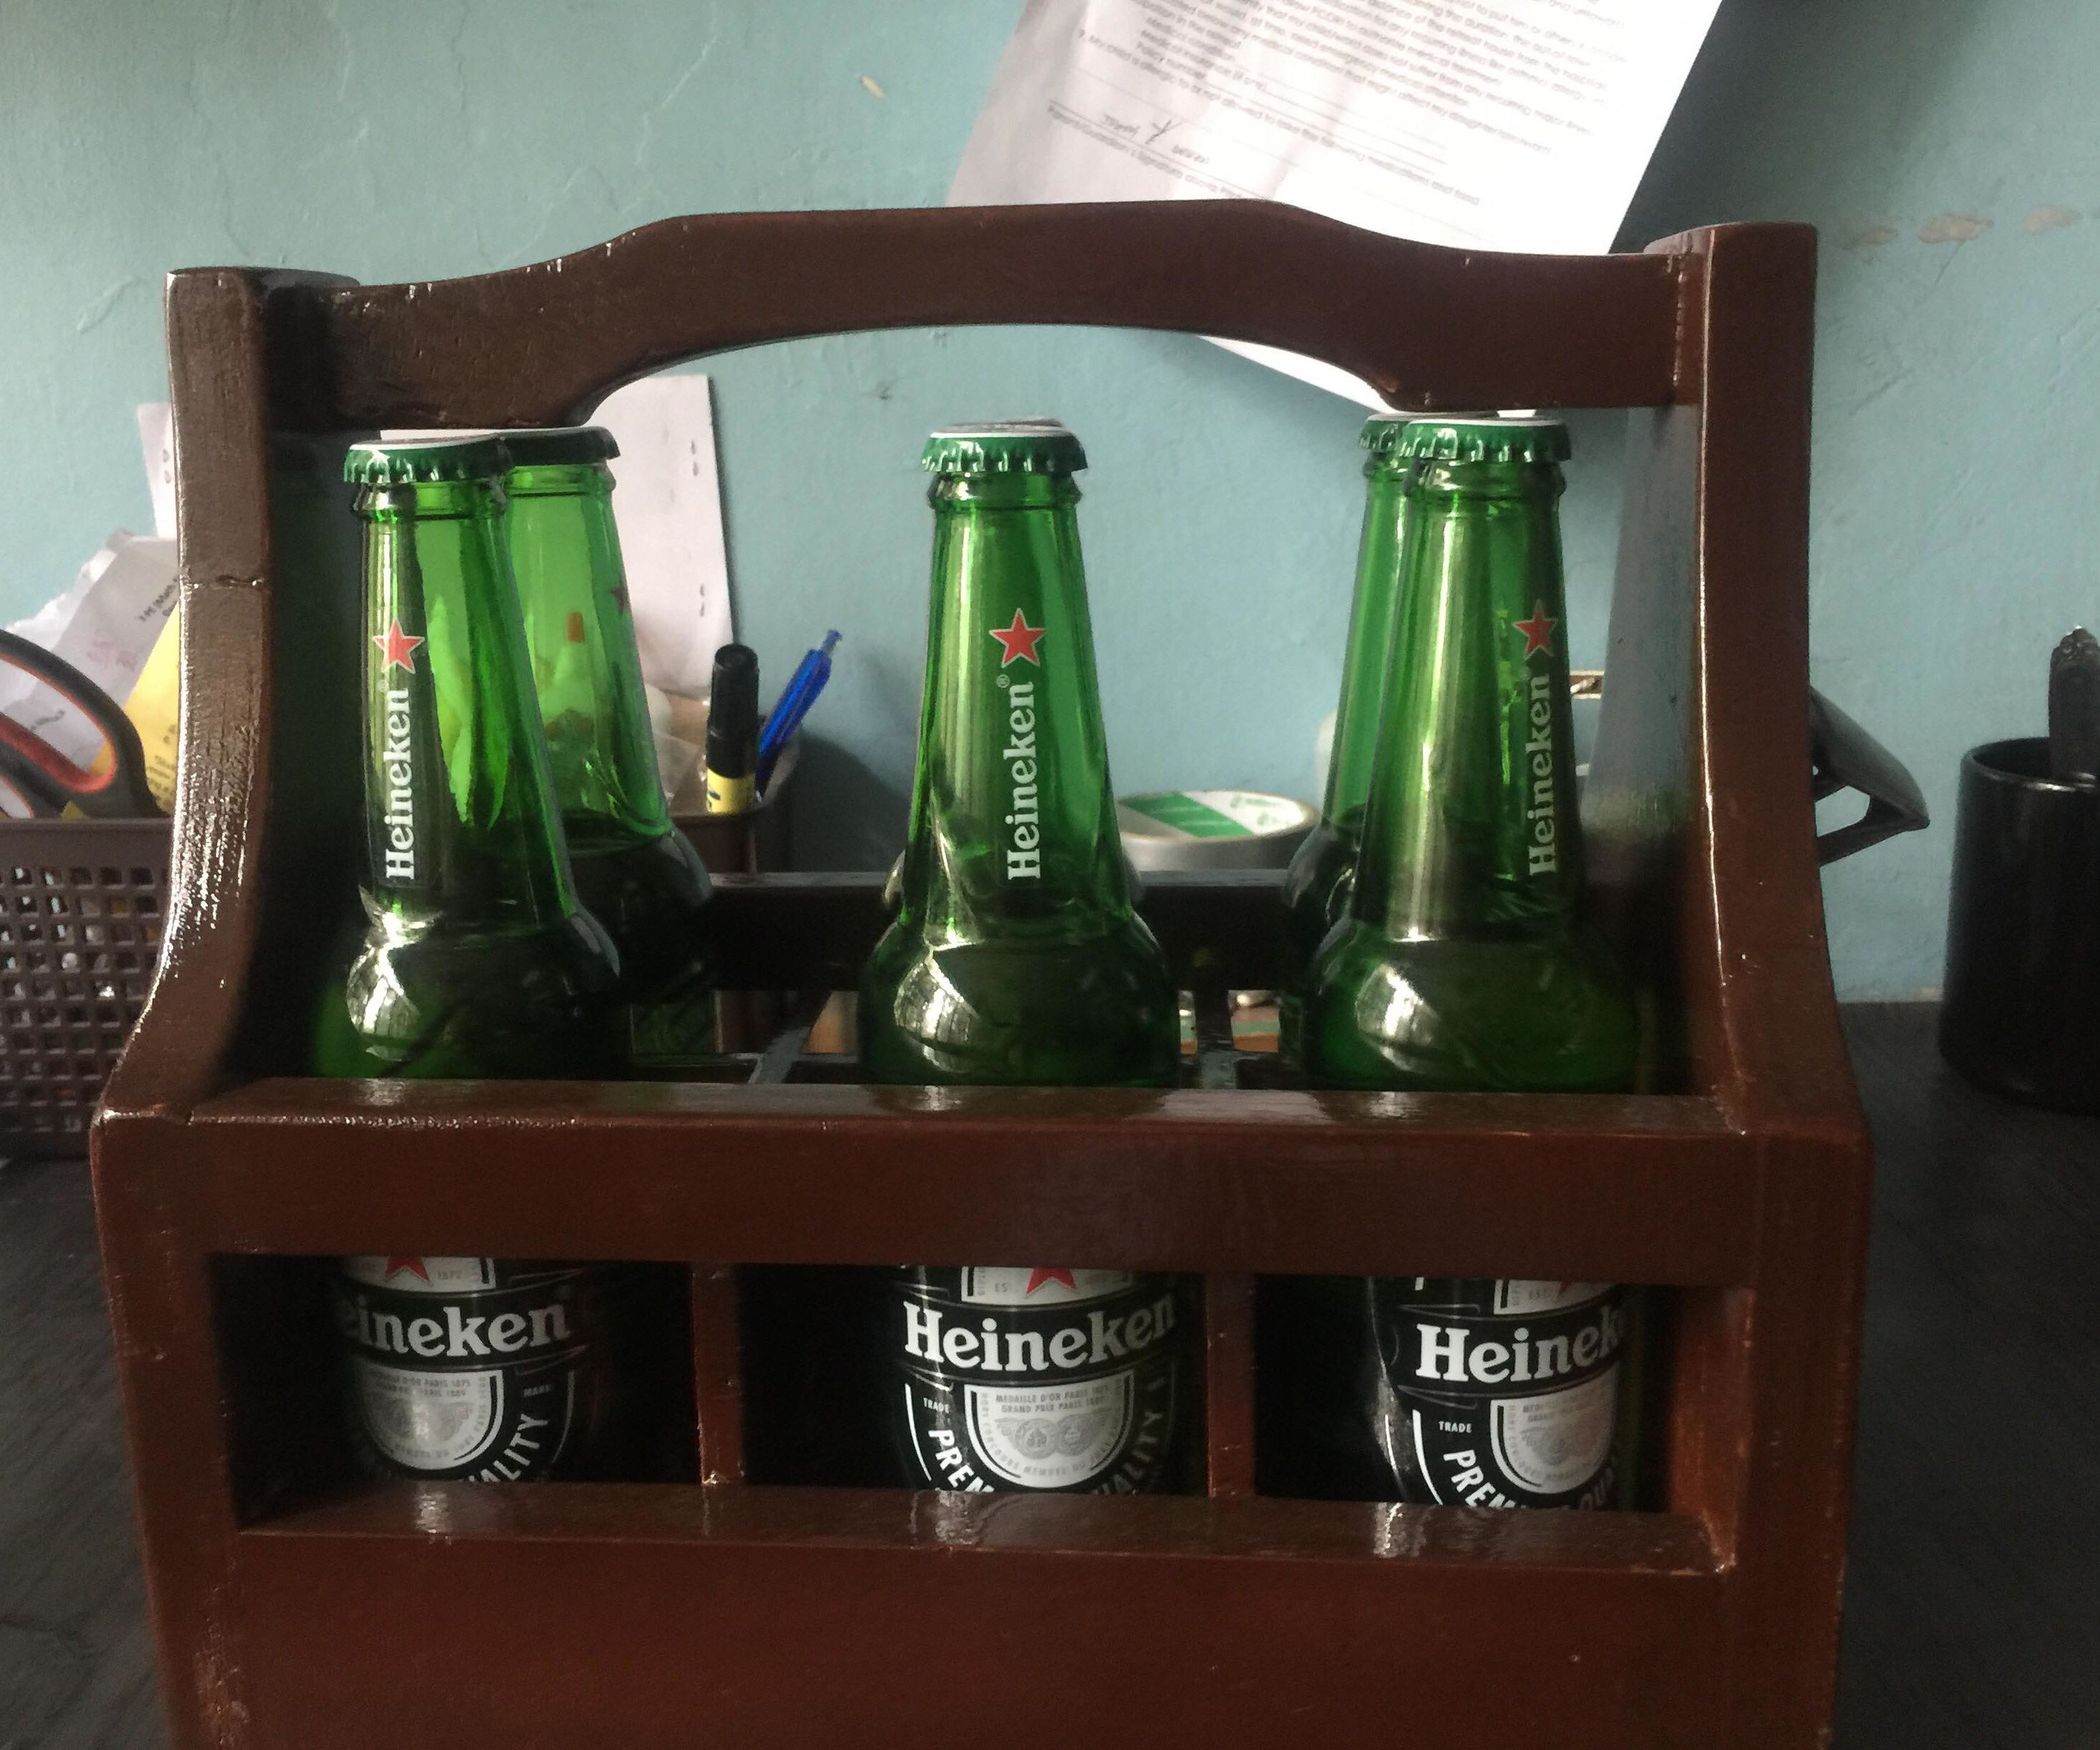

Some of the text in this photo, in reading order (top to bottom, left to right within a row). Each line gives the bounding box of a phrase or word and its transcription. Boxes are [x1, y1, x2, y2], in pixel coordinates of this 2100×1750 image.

[383, 687, 414, 880] Heineken
[1003, 681, 1041, 880] Heineken
[1525, 673, 1557, 875] Heineken
[356, 1294, 572, 1358] ineken
[903, 1293, 1175, 1372] Heineken
[1415, 1303, 1622, 1384] Heinek
[923, 1397, 950, 1414] TRADE
[1438, 1420, 1472, 1434] TRADE
[468, 1412, 549, 1483] ALITY
[927, 1428, 995, 1493] PREM
[1442, 1448, 1519, 1508] PREM
